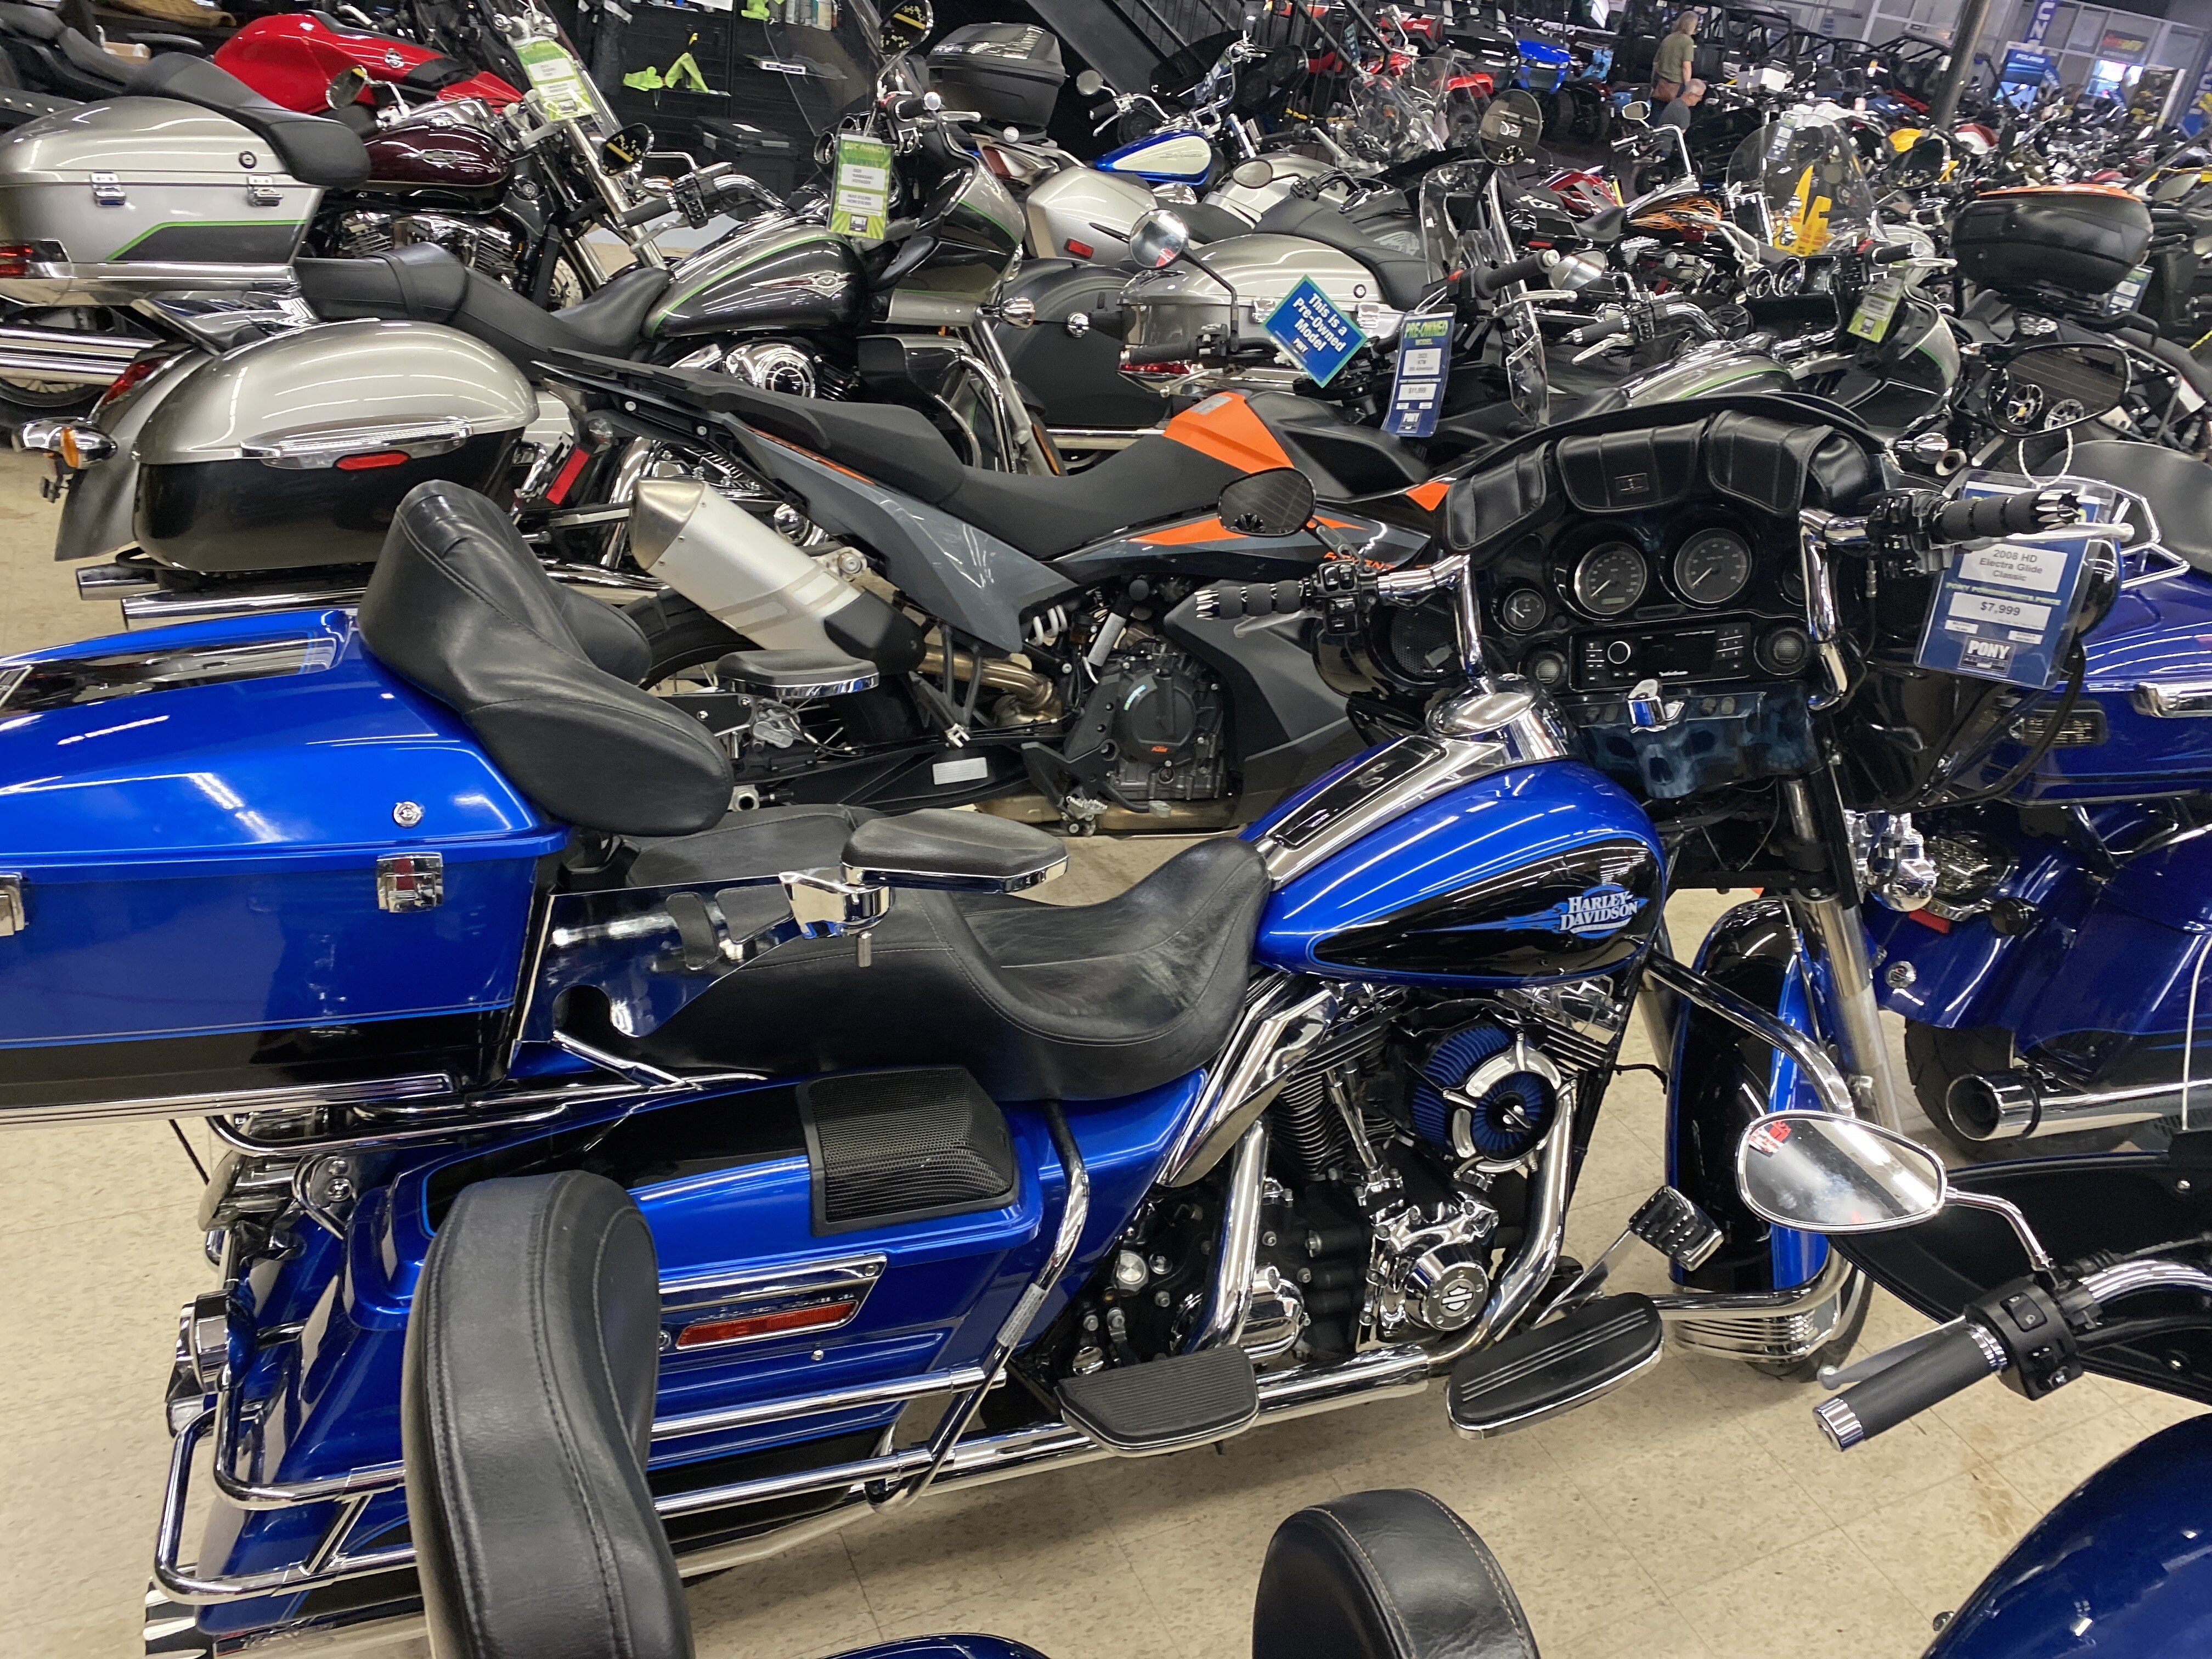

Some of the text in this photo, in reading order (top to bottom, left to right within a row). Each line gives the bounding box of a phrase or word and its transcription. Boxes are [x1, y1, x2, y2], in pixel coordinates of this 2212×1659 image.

[1308, 292, 1347, 336] This is a
[1293, 297, 1347, 353] Pre-Owned
[1404, 320, 1448, 338] PRE-OWNED
[1294, 318, 1327, 352] Model
[1979, 557, 2043, 574] Electra Glide
[1993, 549, 2038, 563] 2008 HD
[1993, 569, 2028, 582] Classic
[1979, 601, 2021, 616] $7,999
[1967, 640, 2011, 659] PONY
[1567, 890, 1633, 914] HARLEY-
[1559, 901, 1639, 931] DAVIDSON
